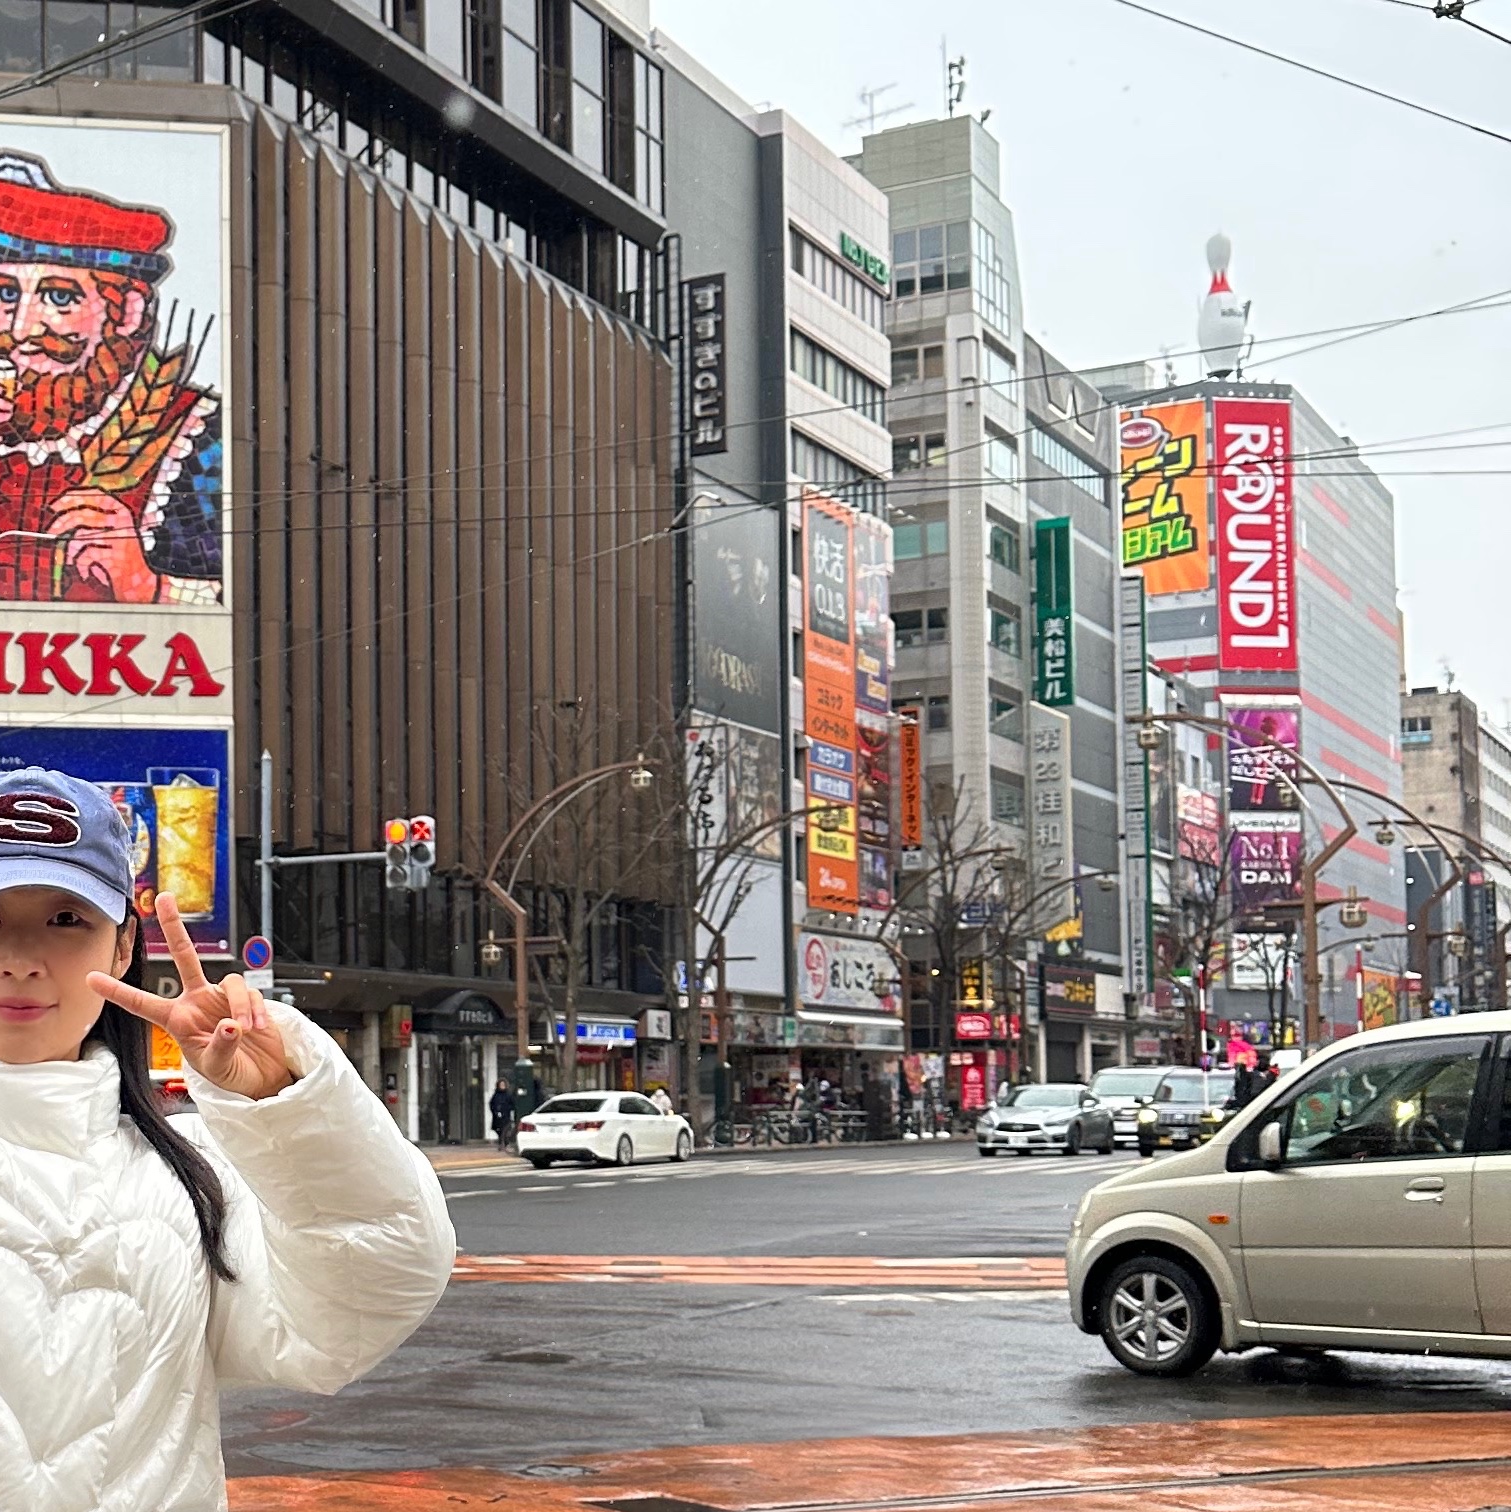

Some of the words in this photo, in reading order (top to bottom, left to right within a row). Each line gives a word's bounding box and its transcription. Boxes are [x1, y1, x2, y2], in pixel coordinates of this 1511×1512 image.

[1222, 423, 1290, 649] ROUND1
[1042, 616, 1068, 703] 美松ビル
